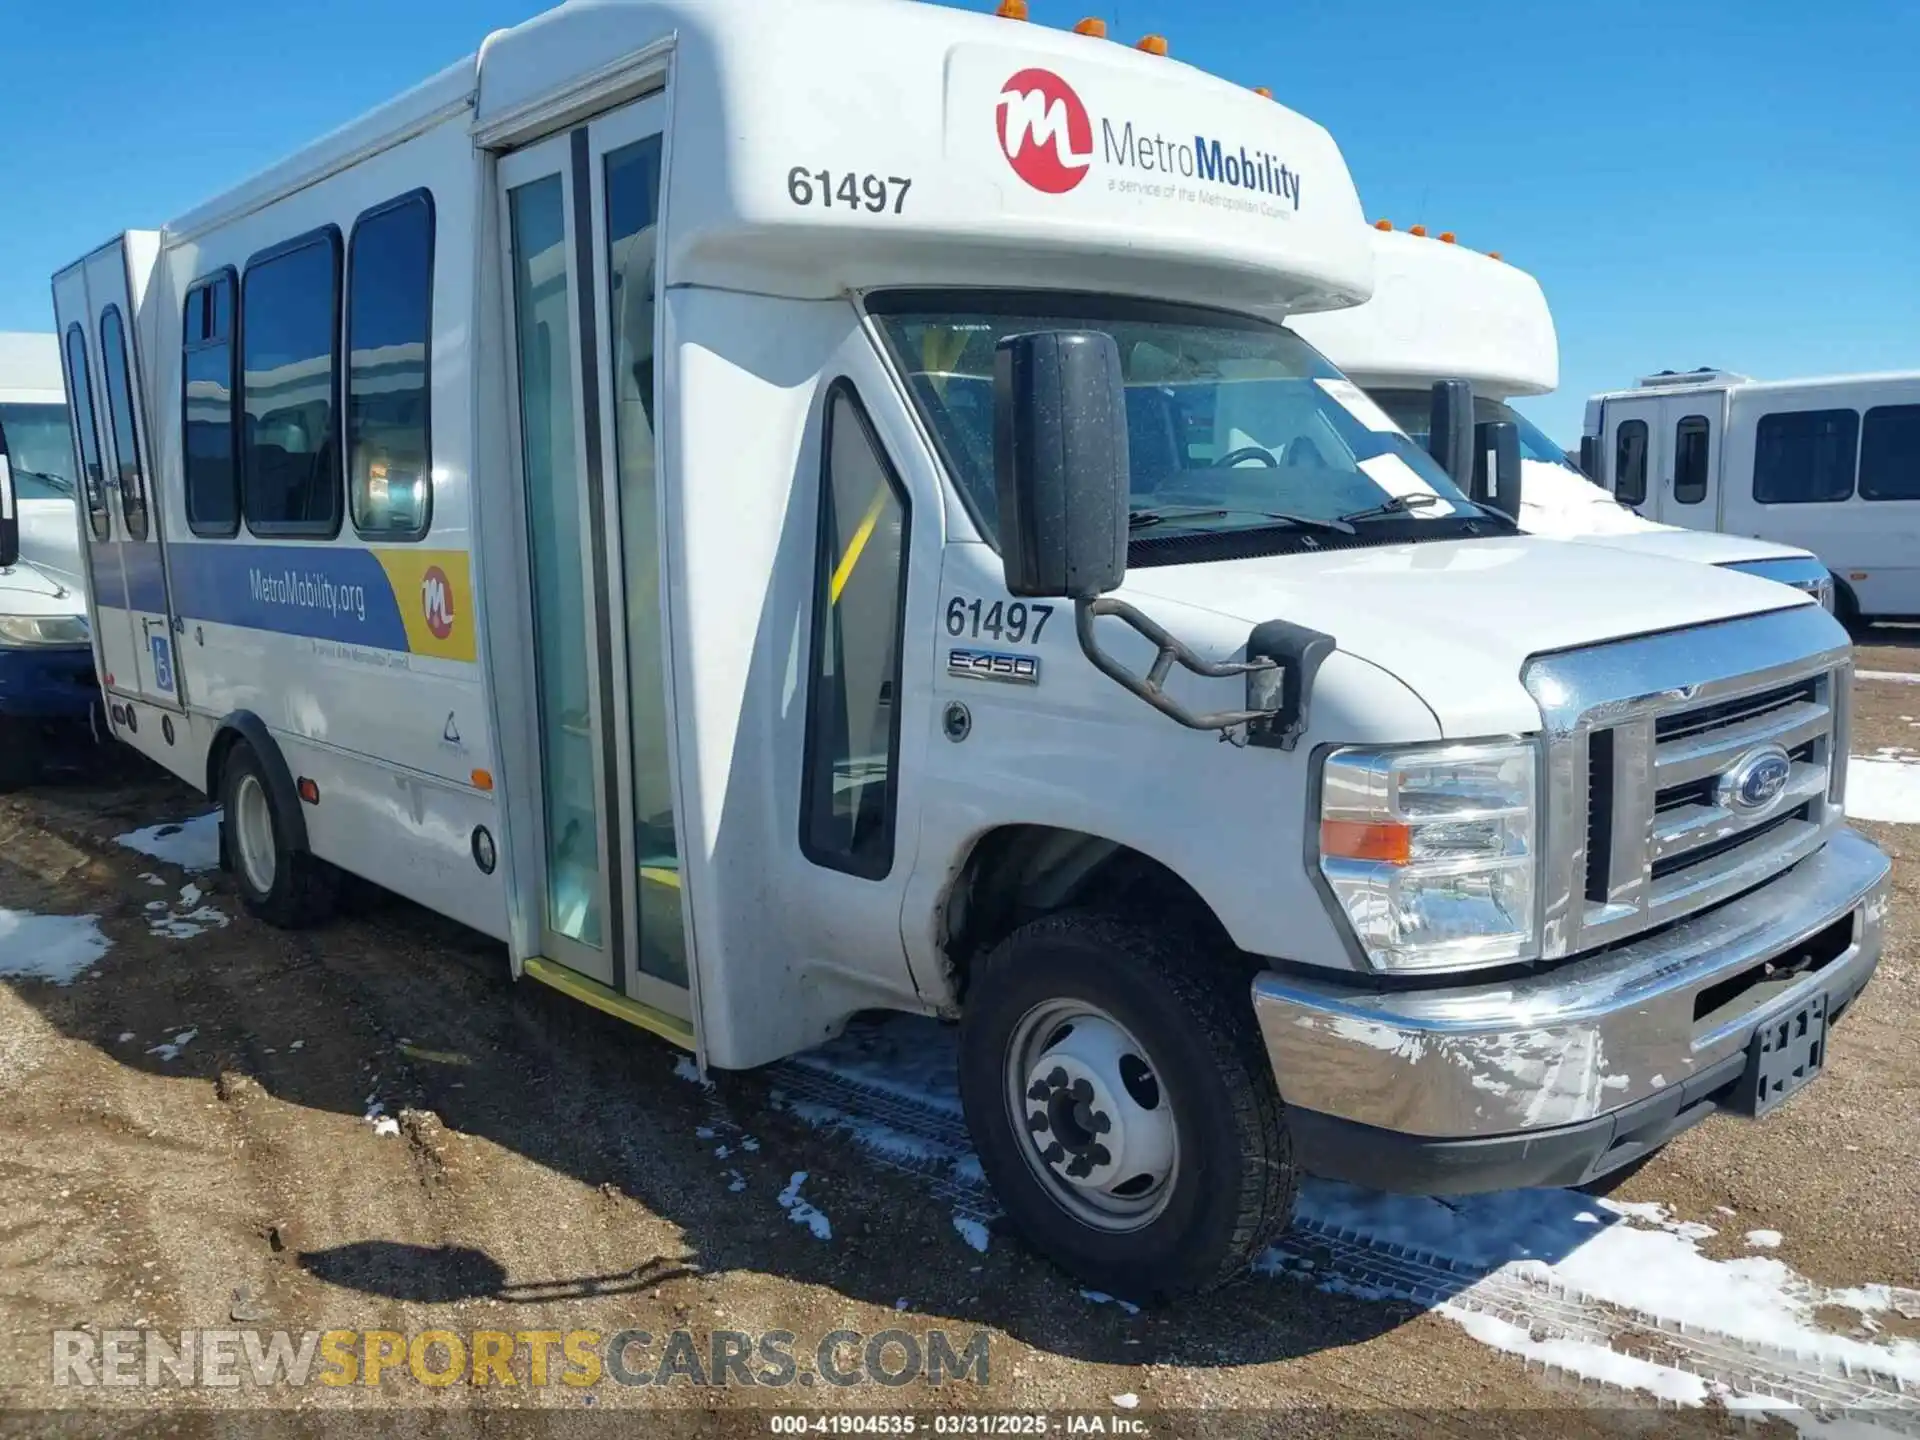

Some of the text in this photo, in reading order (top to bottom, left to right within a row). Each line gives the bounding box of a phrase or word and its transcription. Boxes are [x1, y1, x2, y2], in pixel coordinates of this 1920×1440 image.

[787, 165, 912, 214] 61497
[1101, 116, 1301, 213] MetroMobility
[249, 567, 366, 622] MetroMobility.org
[946, 596, 1055, 645] 61497
